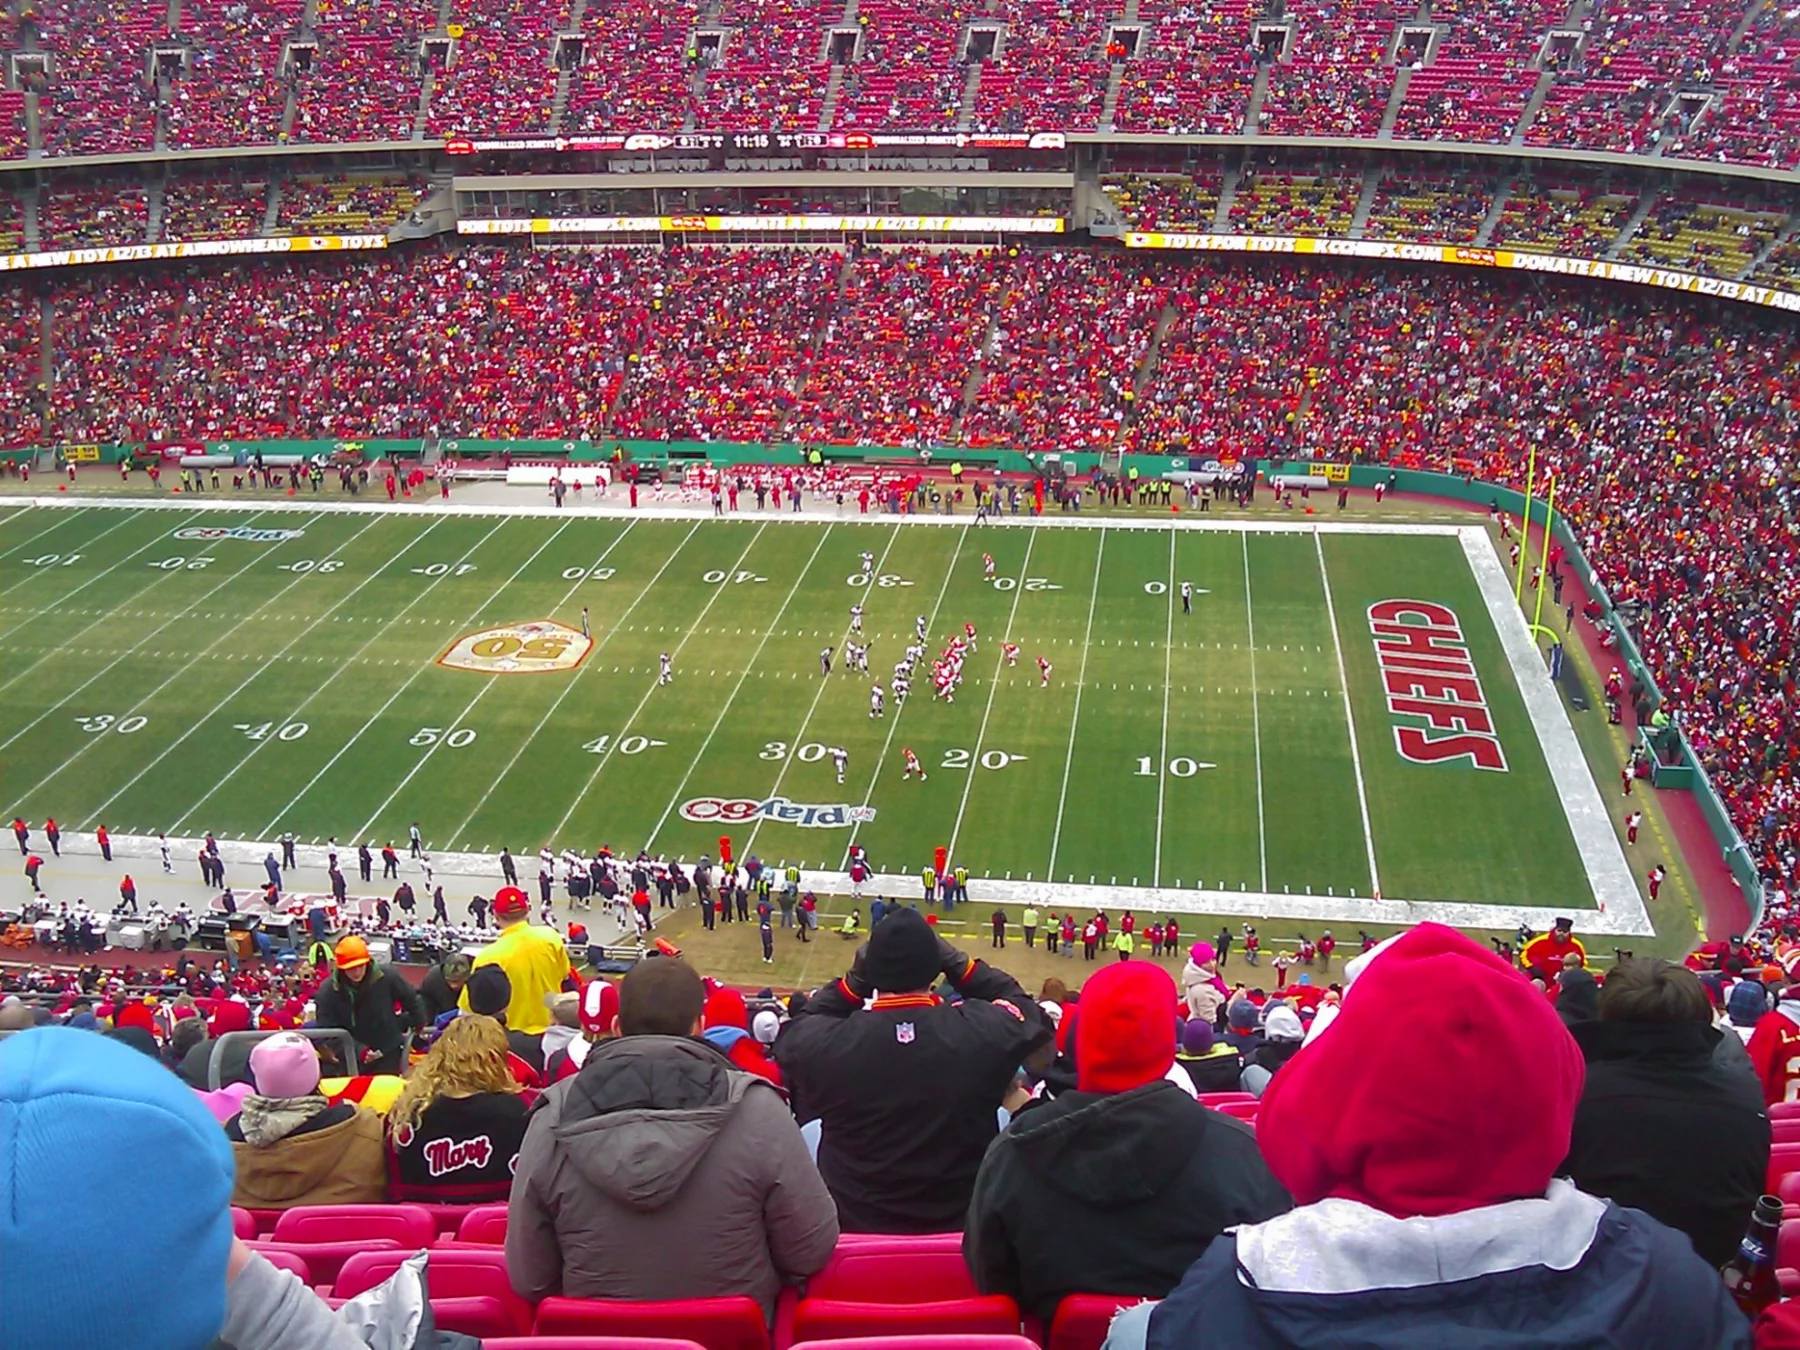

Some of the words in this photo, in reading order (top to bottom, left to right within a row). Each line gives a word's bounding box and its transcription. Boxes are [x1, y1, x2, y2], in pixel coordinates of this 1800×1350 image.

[733, 134, 769, 148] 11:15
[12, 254, 28, 270] A
[29, 251, 69, 268] NEW
[72, 247, 110, 265] TOY
[115, 245, 152, 261] 12/13
[154, 243, 180, 259] AT
[182, 238, 291, 257] ARROWHEAD
[341, 234, 384, 250] TOYS
[1164, 233, 1211, 248] TOYS
[1212, 235, 1249, 250] FOR
[1250, 237, 1296, 252] TOTS
[1513, 252, 1591, 275] DONATE
[1591, 261, 1609, 277] A
[1609, 263, 1653, 284] NEW
[1654, 270, 1695, 290] TOY
[1697, 276, 1740, 299] 12/13
[1741, 284, 1773, 305] AT
[1367, 598, 1510, 772] CHIEFS
[409, 728, 477, 748] 50
[424, 1135, 493, 1177] Mary
